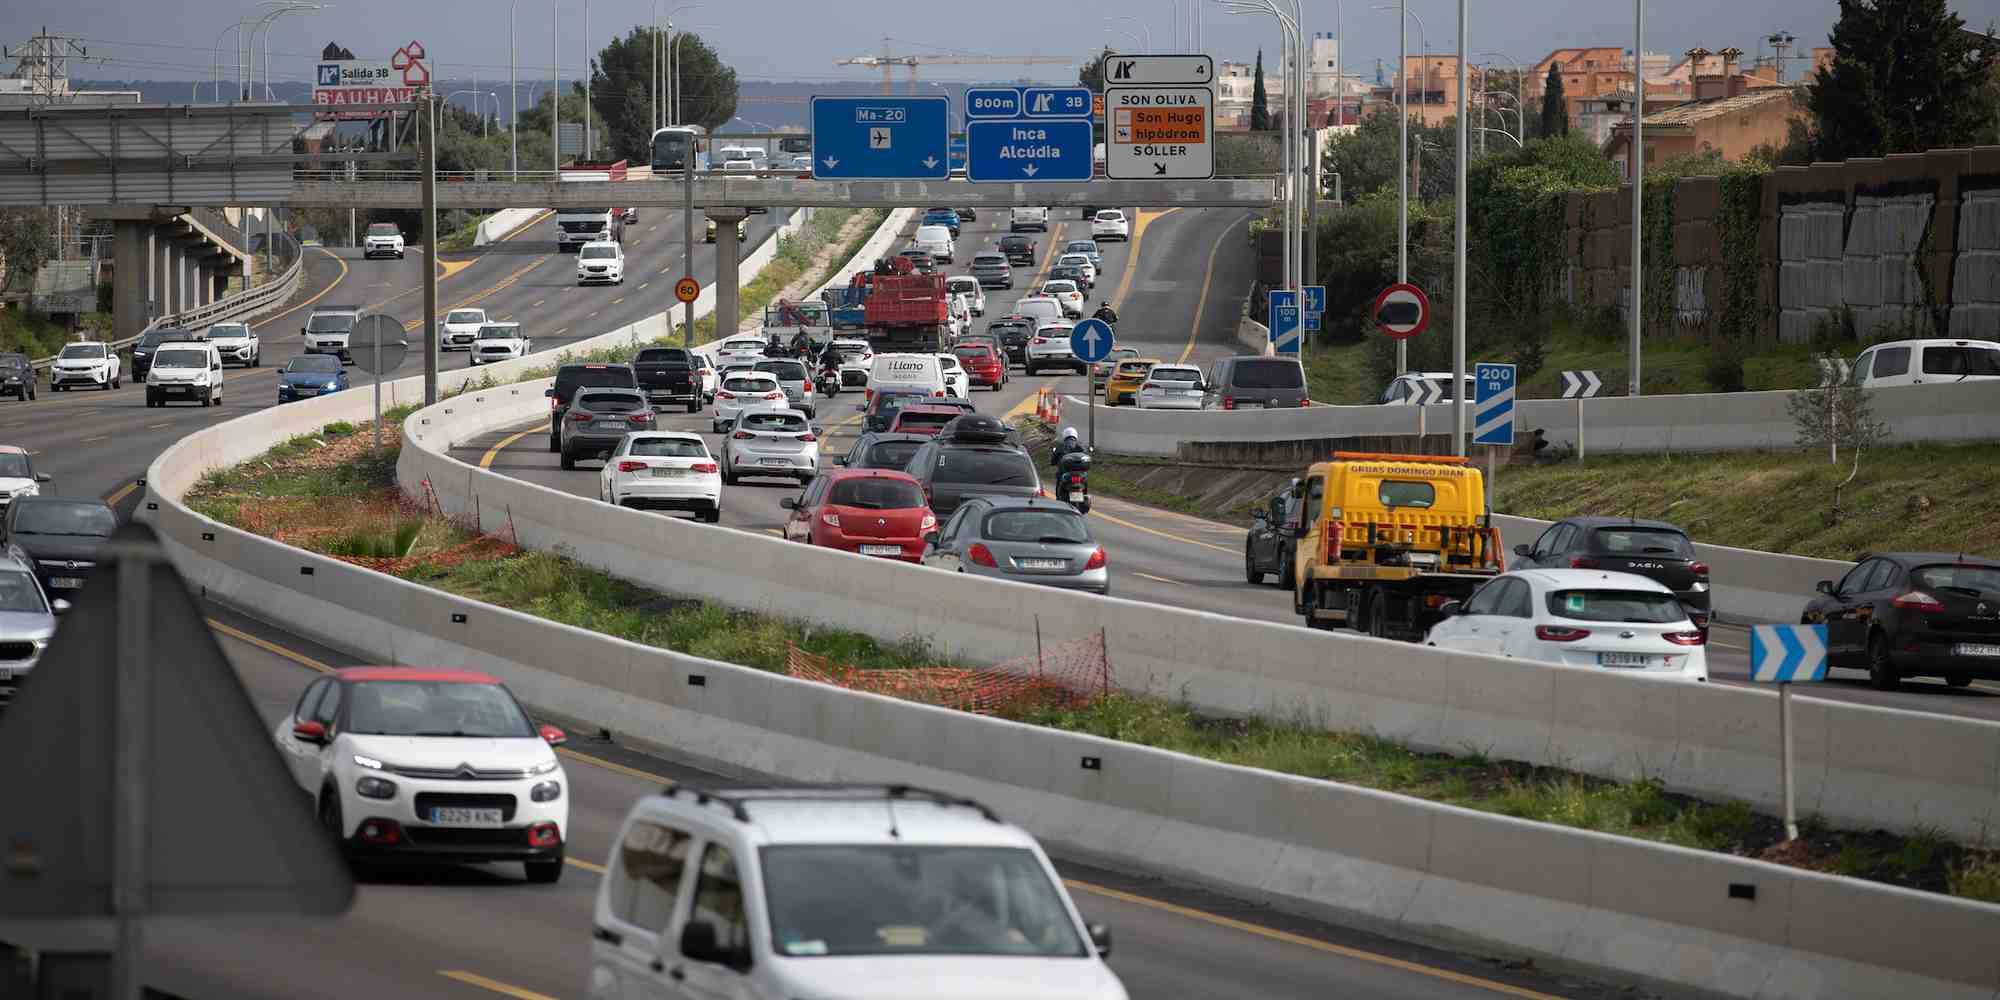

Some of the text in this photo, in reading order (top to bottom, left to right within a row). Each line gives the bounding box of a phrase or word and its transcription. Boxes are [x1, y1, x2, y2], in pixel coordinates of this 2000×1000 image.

[342, 68, 389, 79] Salida 3B
[1196, 65, 1205, 74] 4
[1065, 97, 1083, 107] 3B
[1121, 95, 1197, 105] SON OLIVA
[858, 110, 904, 121] Ma-20
[1136, 112, 1202, 125] Son Hugo
[1012, 127, 1046, 140] Inca
[999, 145, 1061, 158] Alcúdia
[680, 286, 694, 295] 60
[1281, 308, 1296, 316] 100
[1481, 368, 1510, 380] 200
[1489, 381, 1501, 391] m
[1351, 465, 1385, 474] GRUAS
[1388, 466, 1436, 476] DOMINGO
